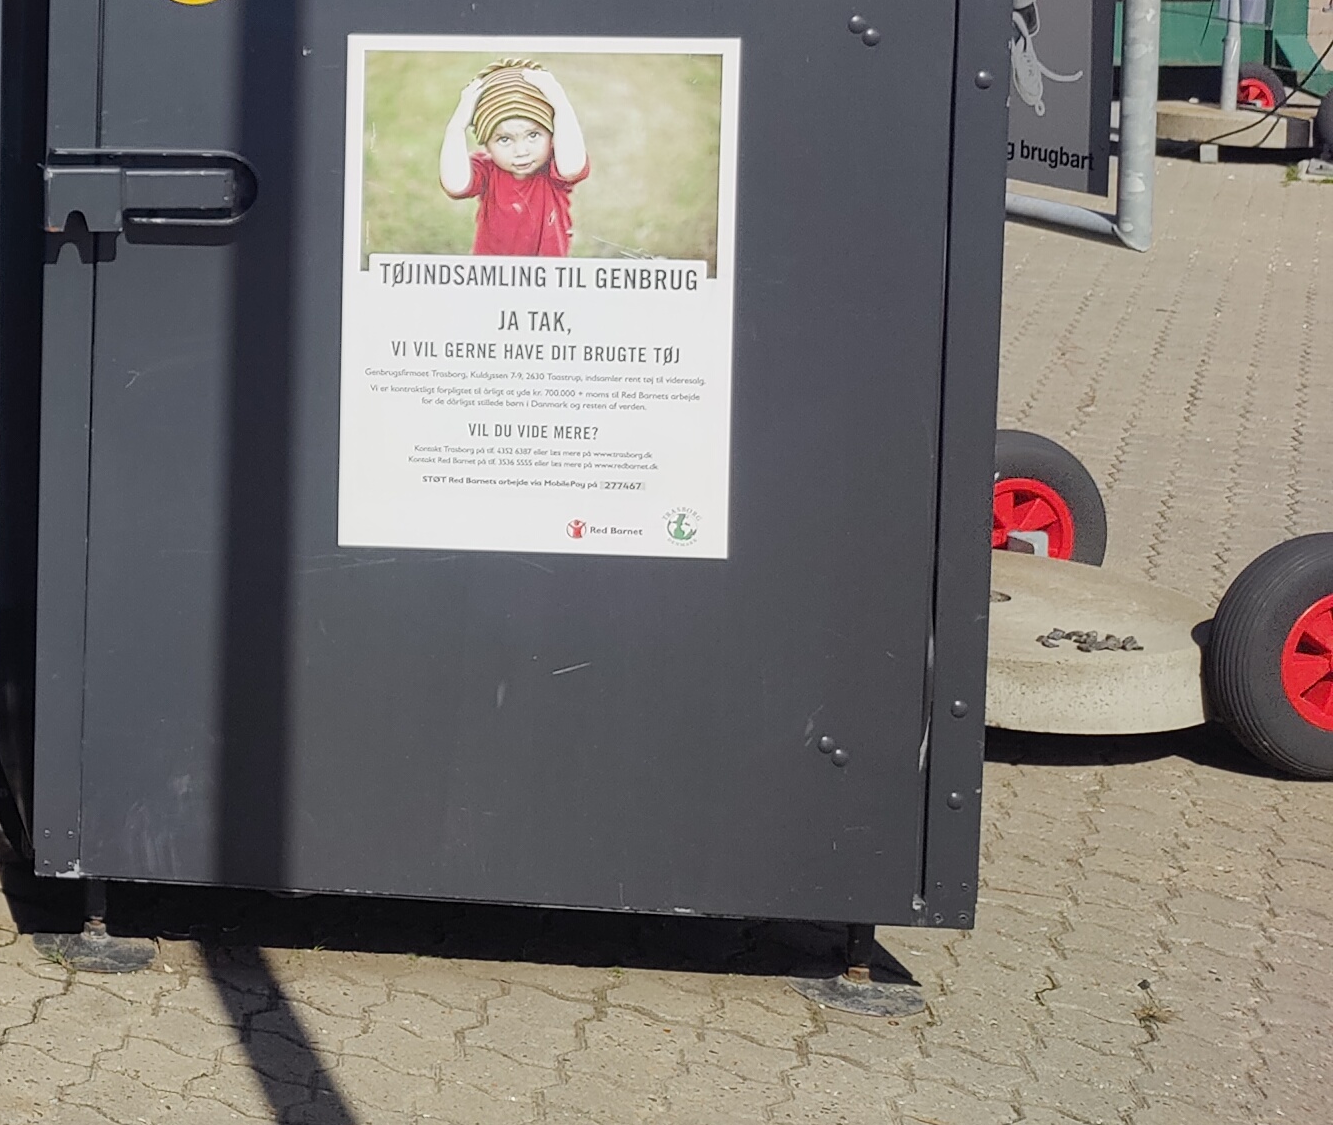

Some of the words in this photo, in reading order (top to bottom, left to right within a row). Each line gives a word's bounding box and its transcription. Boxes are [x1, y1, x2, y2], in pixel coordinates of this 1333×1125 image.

[1020, 140, 1095, 171] brugbart
[380, 262, 546, 287] TØJINDSAMLING
[554, 266, 587, 288] TIL
[595, 267, 697, 291] GENBRUG
[497, 310, 519, 331] JA
[527, 311, 571, 335] TAK,
[391, 340, 406, 357] VI
[413, 341, 438, 358] VIL
[444, 342, 497, 359] GERNE
[504, 343, 544, 360] HAVE
[551, 344, 577, 361] DIT
[583, 345, 647, 363] BRUGTE
[653, 346, 680, 366] TØJ
[364, 367, 429, 378] Genbrugsfirmaet
[470, 371, 508, 381] Kuldyssen
[525, 372, 545, 380] 2630
[546, 372, 583, 383] Taastrup,
[585, 374, 623, 382] indsamler
[655, 375, 664, 384] til
[468, 422, 489, 437] VIL
[494, 423, 512, 438] DU
[517, 424, 548, 439] VIDE
[553, 425, 598, 440] MERE?
[422, 475, 447, 483] STØT
[448, 476, 464, 484] Red
[465, 477, 497, 485] Barnets
[498, 478, 529, 487] arbejde
[543, 479, 586, 489] MobilePay
[586, 481, 598, 490] på
[604, 481, 642, 490] 277467
[589, 526, 608, 534] Red
[610, 526, 643, 536] Barnet
